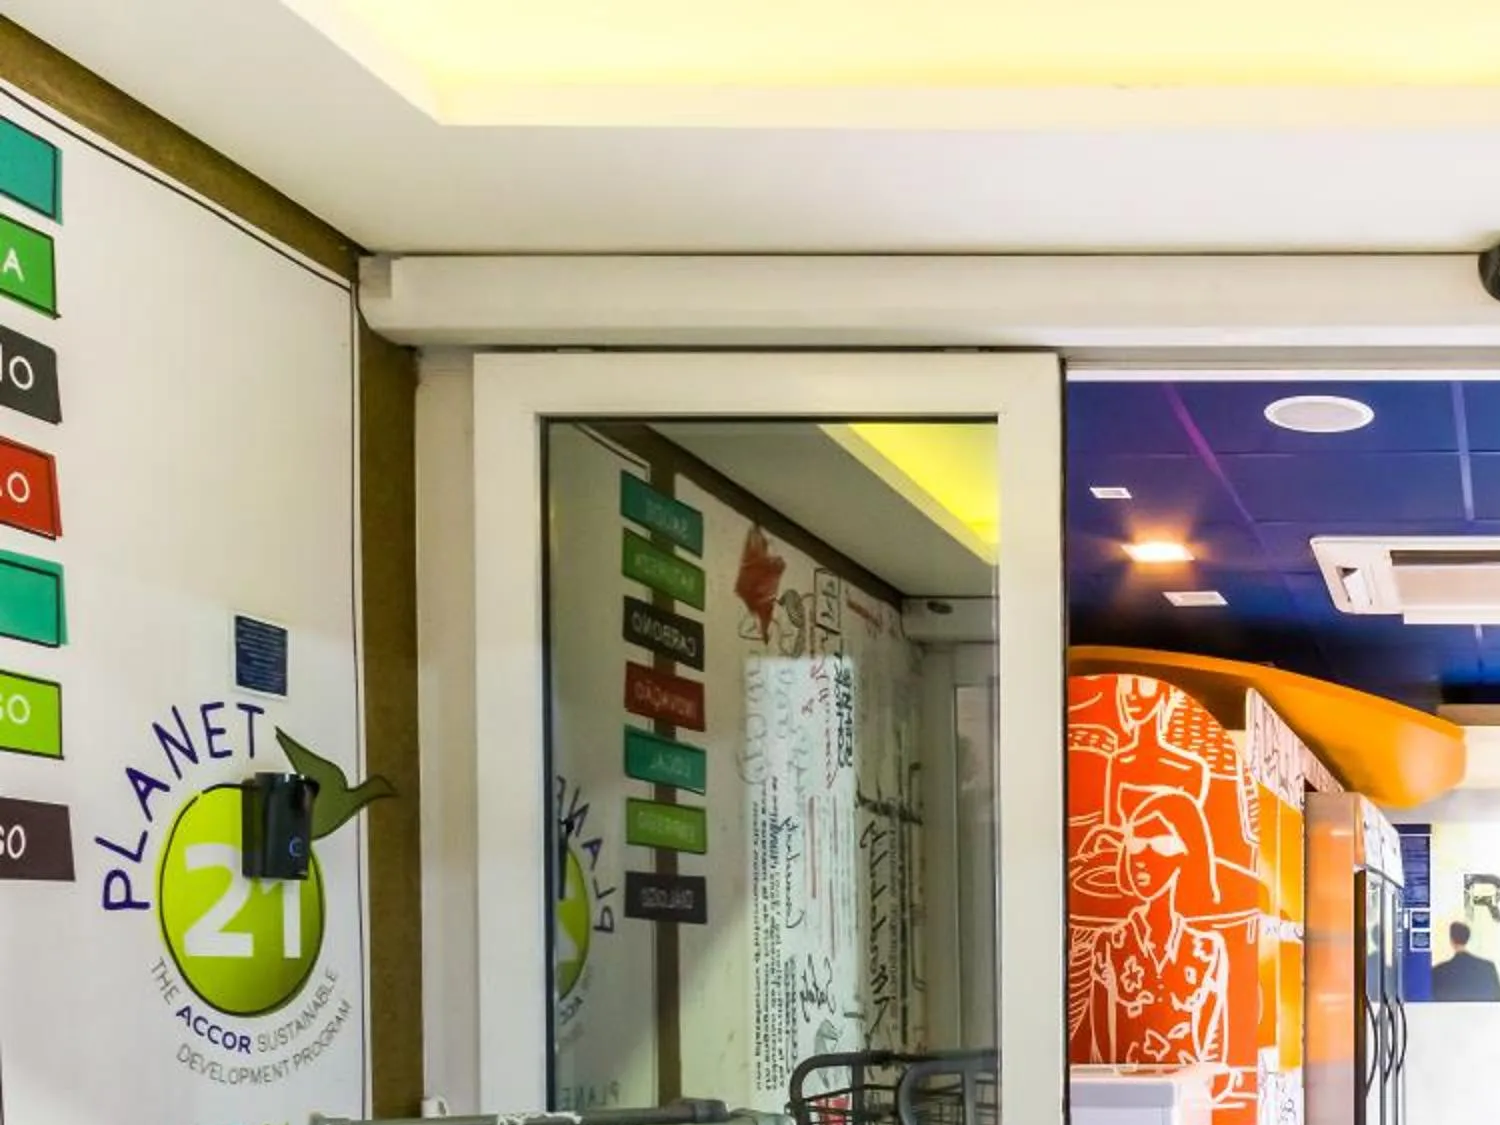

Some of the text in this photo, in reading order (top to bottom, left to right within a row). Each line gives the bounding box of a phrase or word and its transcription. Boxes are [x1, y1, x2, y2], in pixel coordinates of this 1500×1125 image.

[95, 701, 265, 912] PLANET
[183, 842, 303, 959] 21
[151, 957, 339, 1054] THE ACCOR SUSTAINABLE
[176, 999, 352, 1086] DEVELOPMENT PROGRAM
